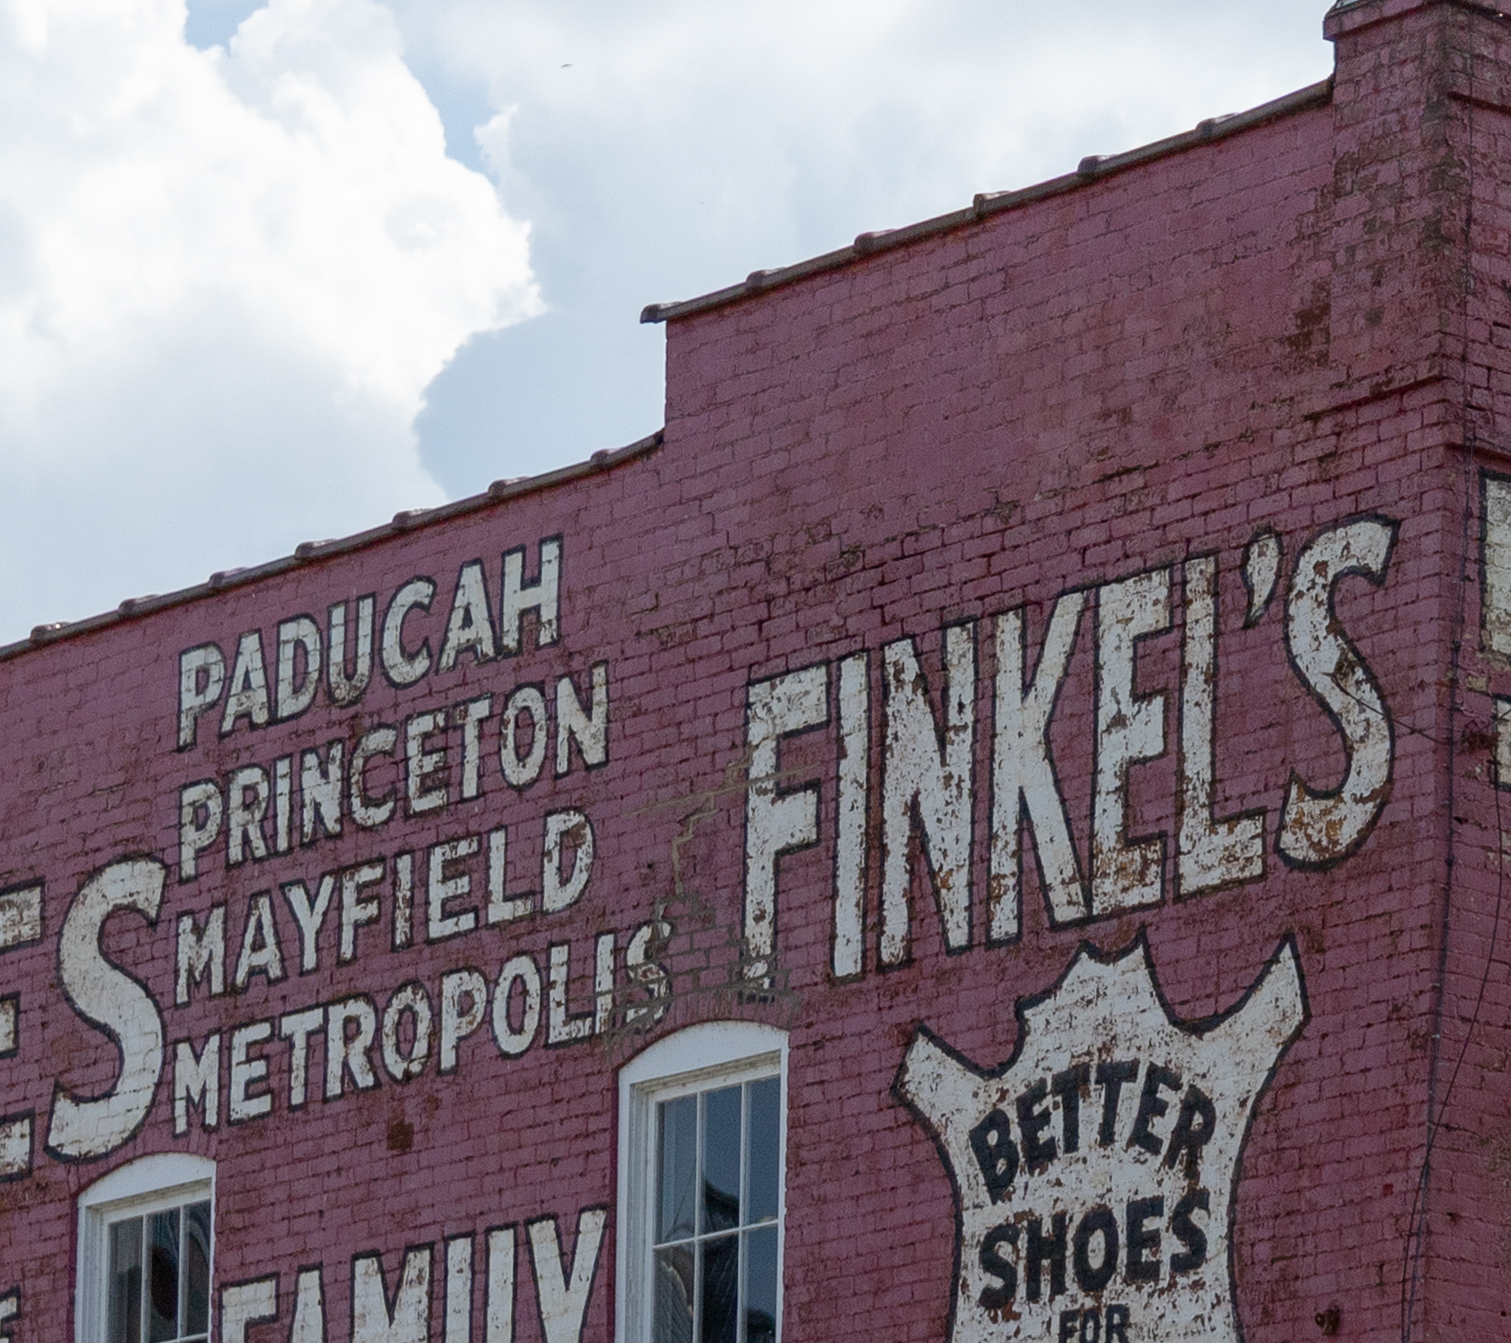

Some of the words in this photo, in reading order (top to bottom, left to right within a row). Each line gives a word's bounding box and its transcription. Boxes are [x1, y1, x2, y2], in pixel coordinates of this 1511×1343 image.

[176, 533, 563, 752] PADUCAH
[177, 659, 610, 882] PRINCETON
[739, 514, 1398, 1003] FINKEL'S
[173, 807, 596, 1005] MAYFIELD
[171, 920, 672, 1138] METROPOLIS
[969, 1058, 1217, 1202] BETTER
[978, 1187, 1212, 1310] SHOES
